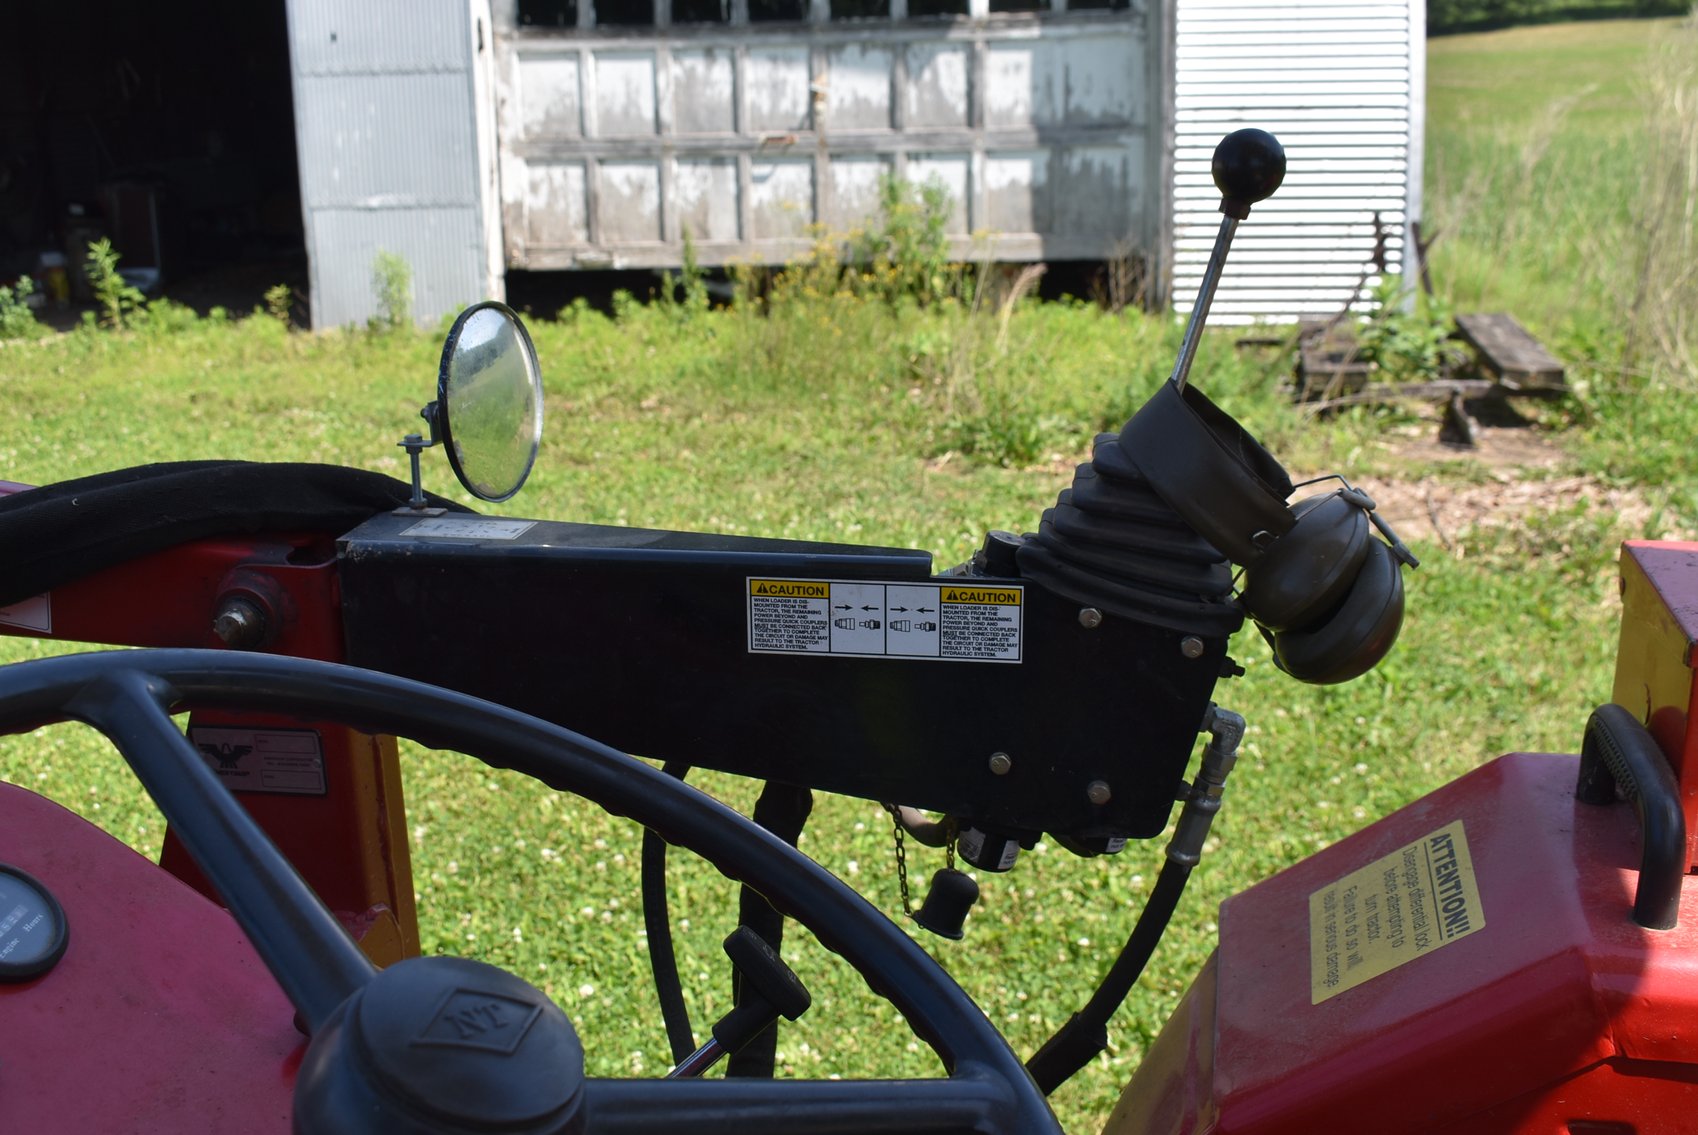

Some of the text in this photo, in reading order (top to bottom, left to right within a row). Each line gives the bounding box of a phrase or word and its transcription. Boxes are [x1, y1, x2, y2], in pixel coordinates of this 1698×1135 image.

[769, 585, 824, 596] CAUTION
[959, 591, 1016, 603] CAUTION
[1430, 833, 1471, 938] ATTENTION!!
[1324, 890, 1337, 913] result
[1343, 886, 1357, 914] Failure
[1402, 846, 1432, 951] Disengage differential lock
[23, 914, 44, 932] Hours
[1345, 912, 1357, 924] to
[1365, 894, 1380, 944] turn tractor.
[1386, 893, 1405, 939] attempting
[1325, 921, 1338, 952] serious
[1345, 924, 1359, 937] do
[1392, 936, 1406, 948] to
[1346, 938, 1358, 950] so
[444, 1003, 510, 1039] NT
